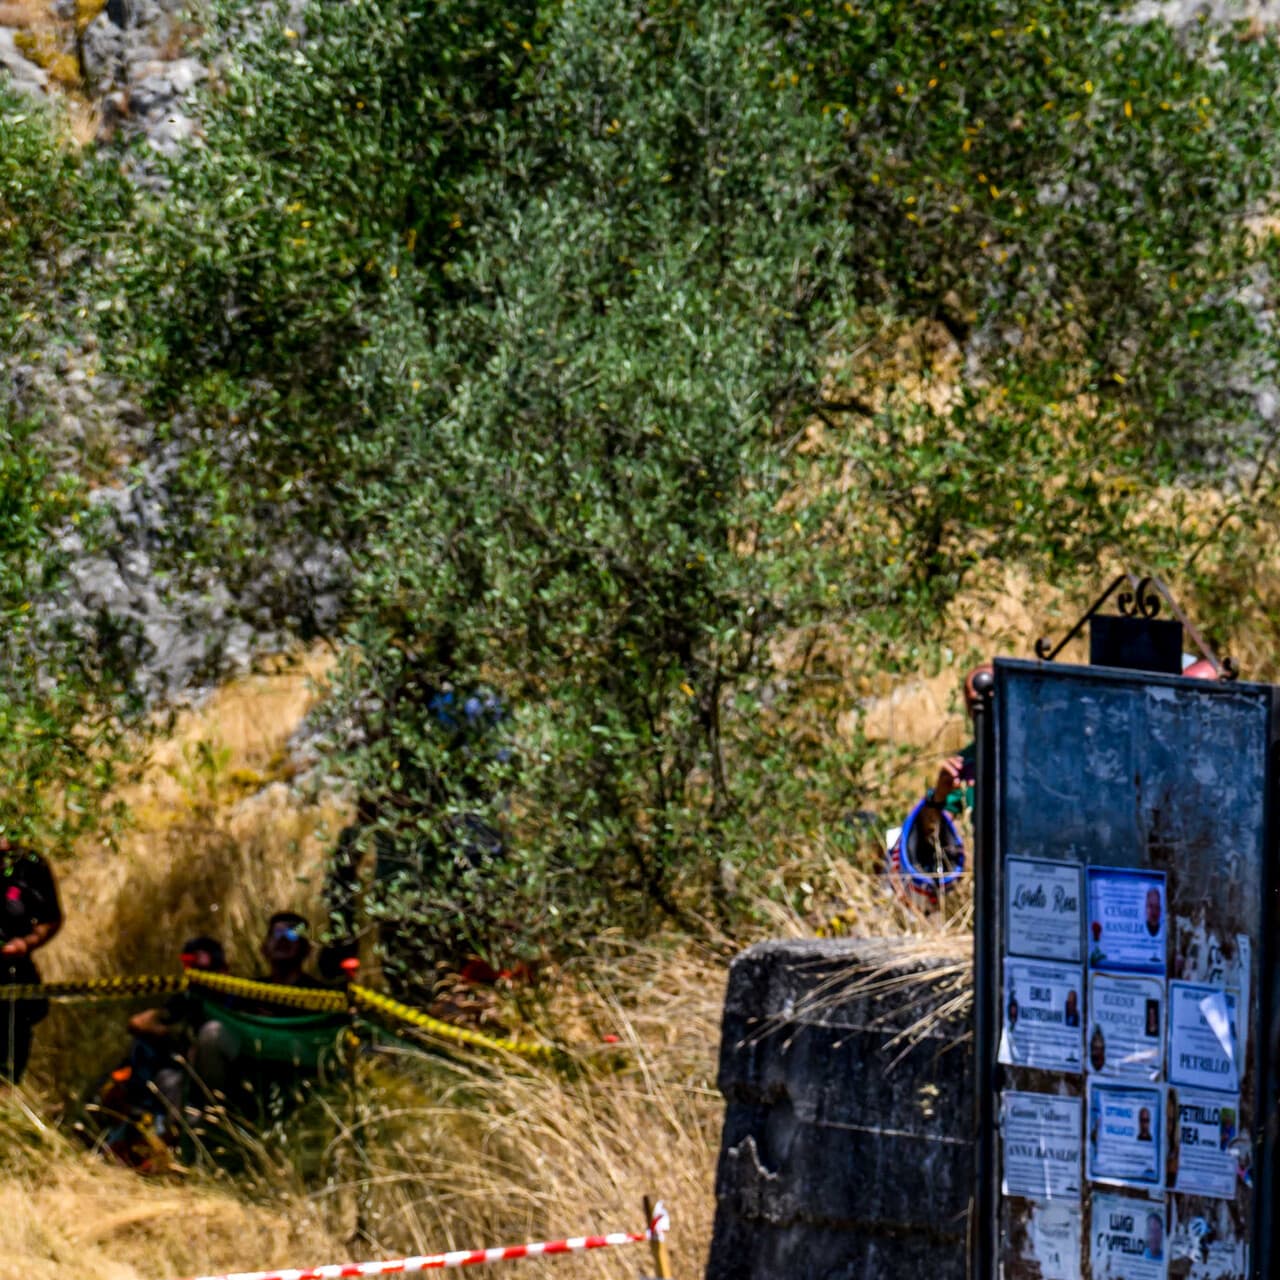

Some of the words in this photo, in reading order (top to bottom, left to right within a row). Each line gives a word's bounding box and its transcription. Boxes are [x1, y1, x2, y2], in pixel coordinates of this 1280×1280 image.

[1180, 1053, 1230, 1075] PETRILLO
[1179, 1105, 1219, 1126] PETRILLO
[1109, 1213, 1134, 1233] LUIGI
